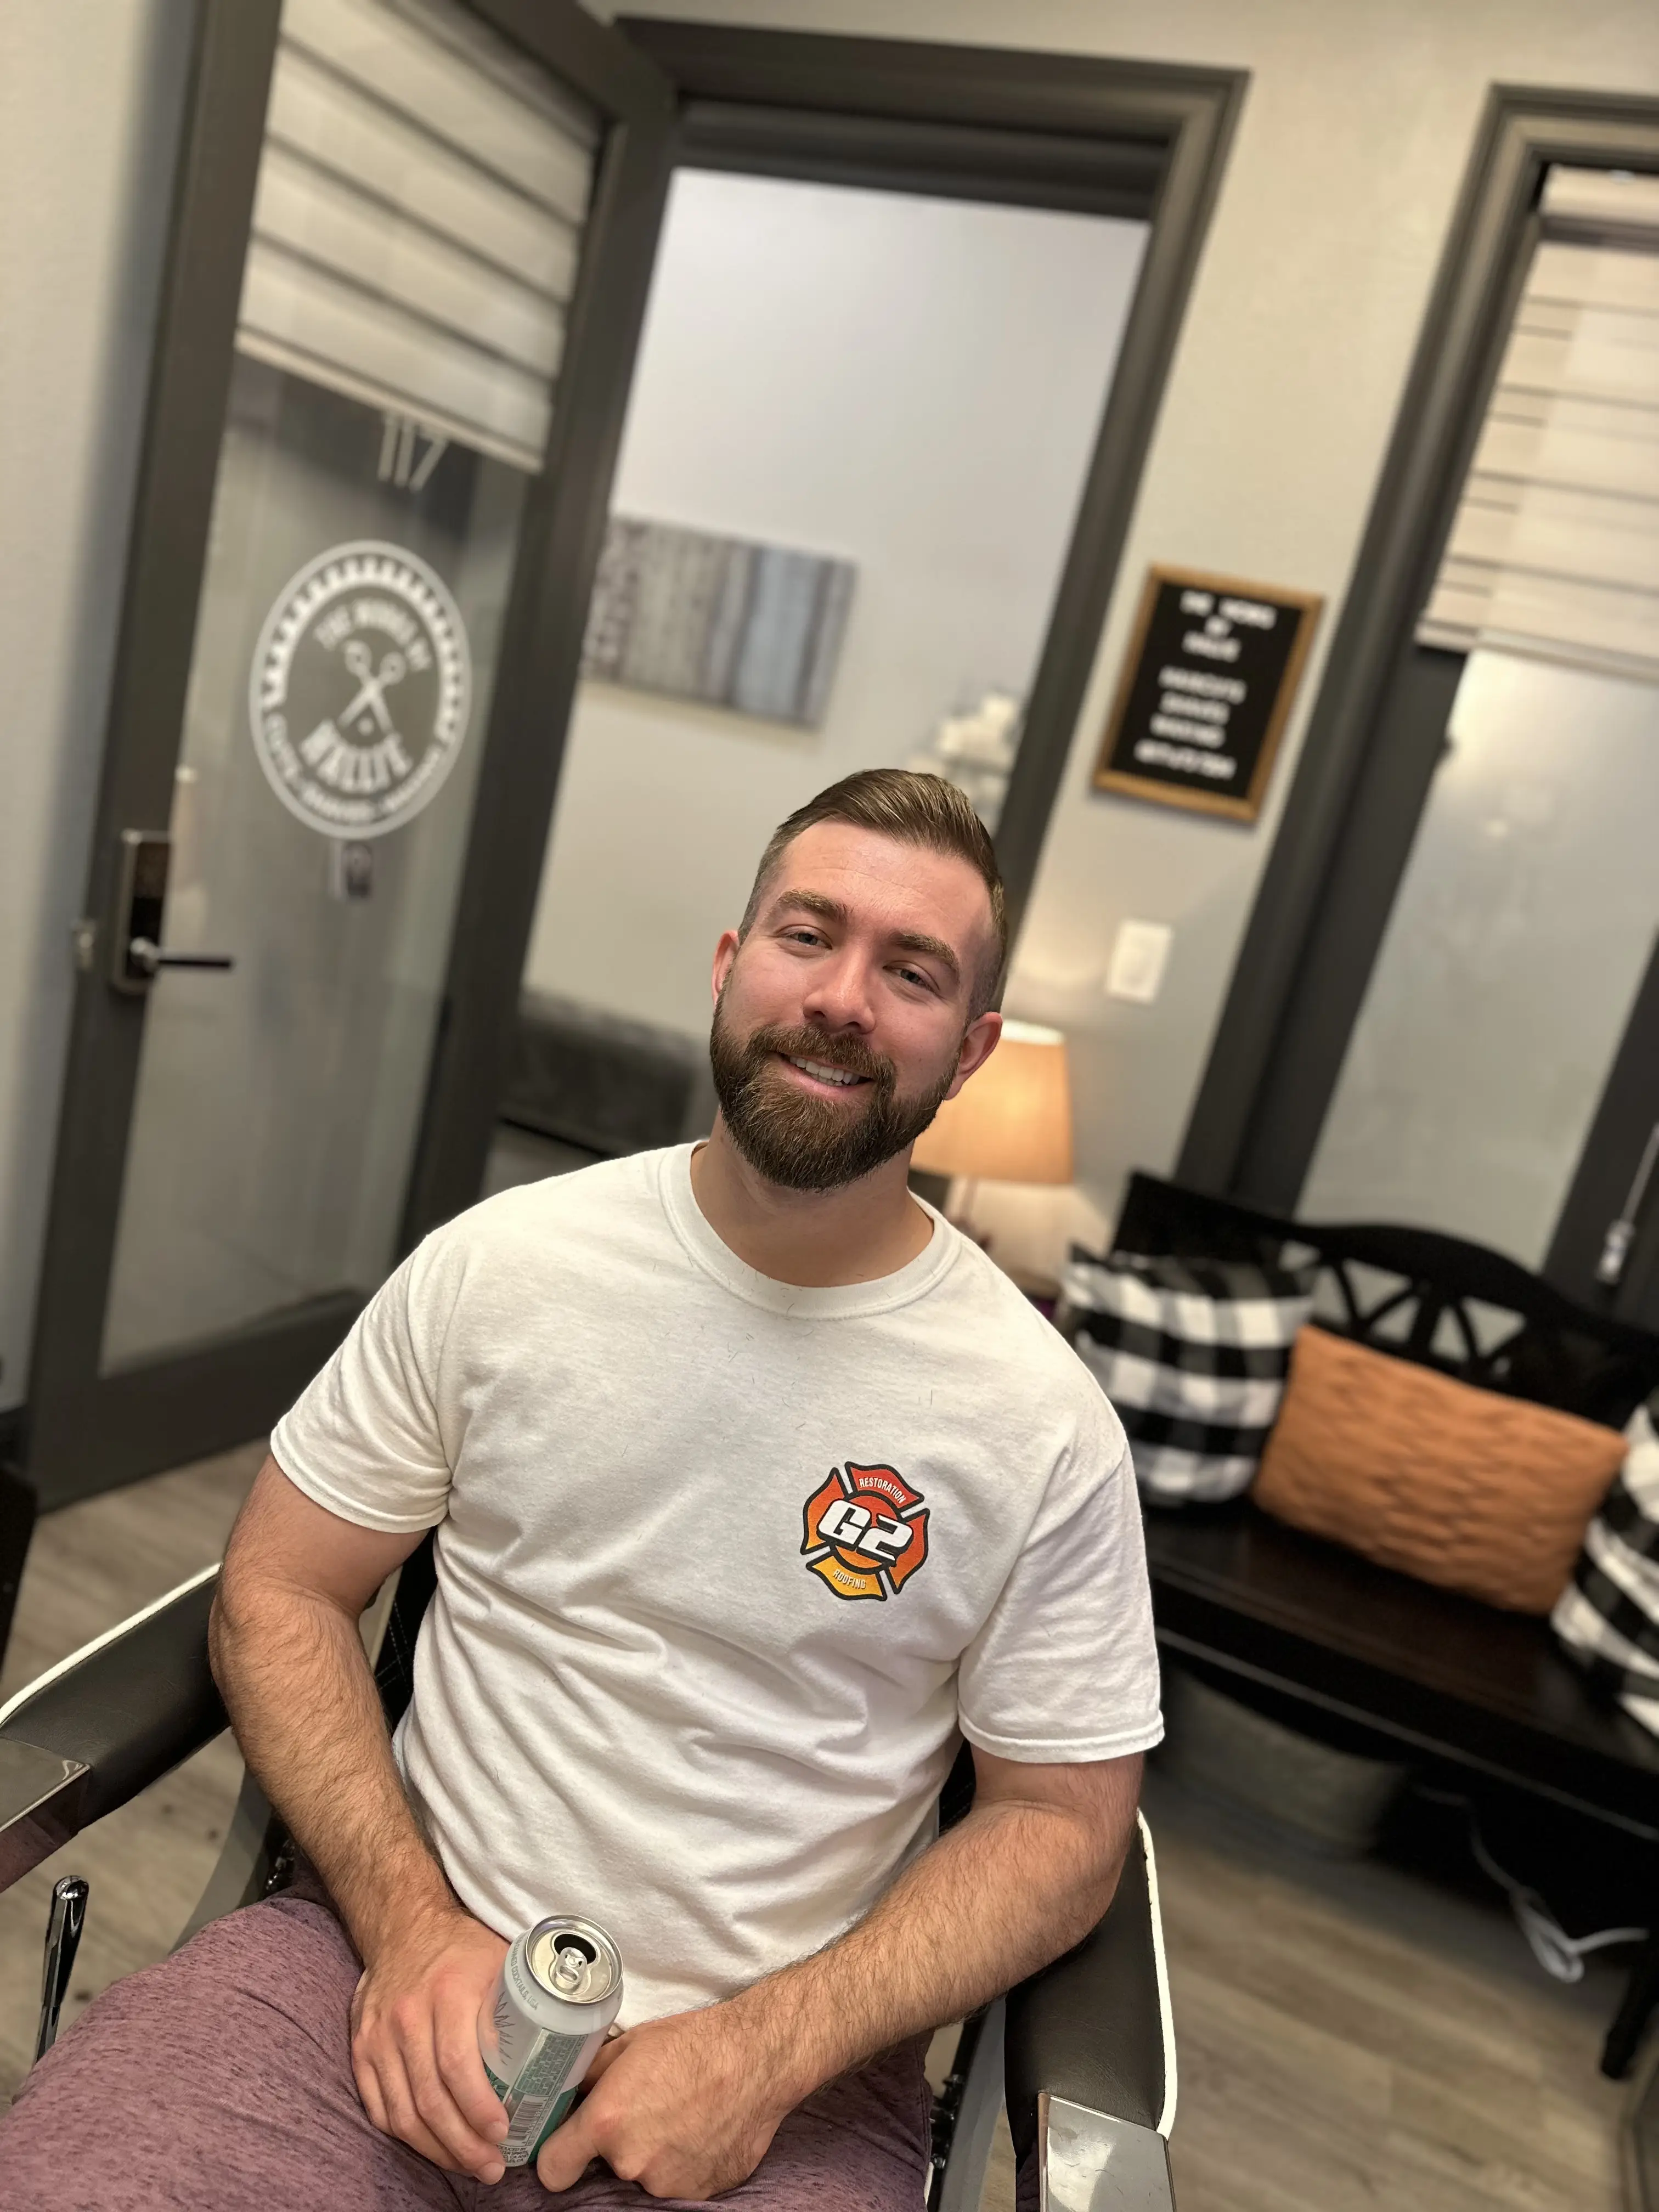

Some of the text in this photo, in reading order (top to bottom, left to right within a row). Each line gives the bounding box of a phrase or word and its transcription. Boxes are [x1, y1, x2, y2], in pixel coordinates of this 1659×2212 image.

[378, 411, 449, 493] 117
[859, 1477, 906, 1504] RESTORATION
[817, 1499, 914, 1564] G2
[832, 1568, 866, 1589] ROOFING
[511, 1966, 529, 2000] COCKTAILS,
[527, 1995, 539, 2010] USA
